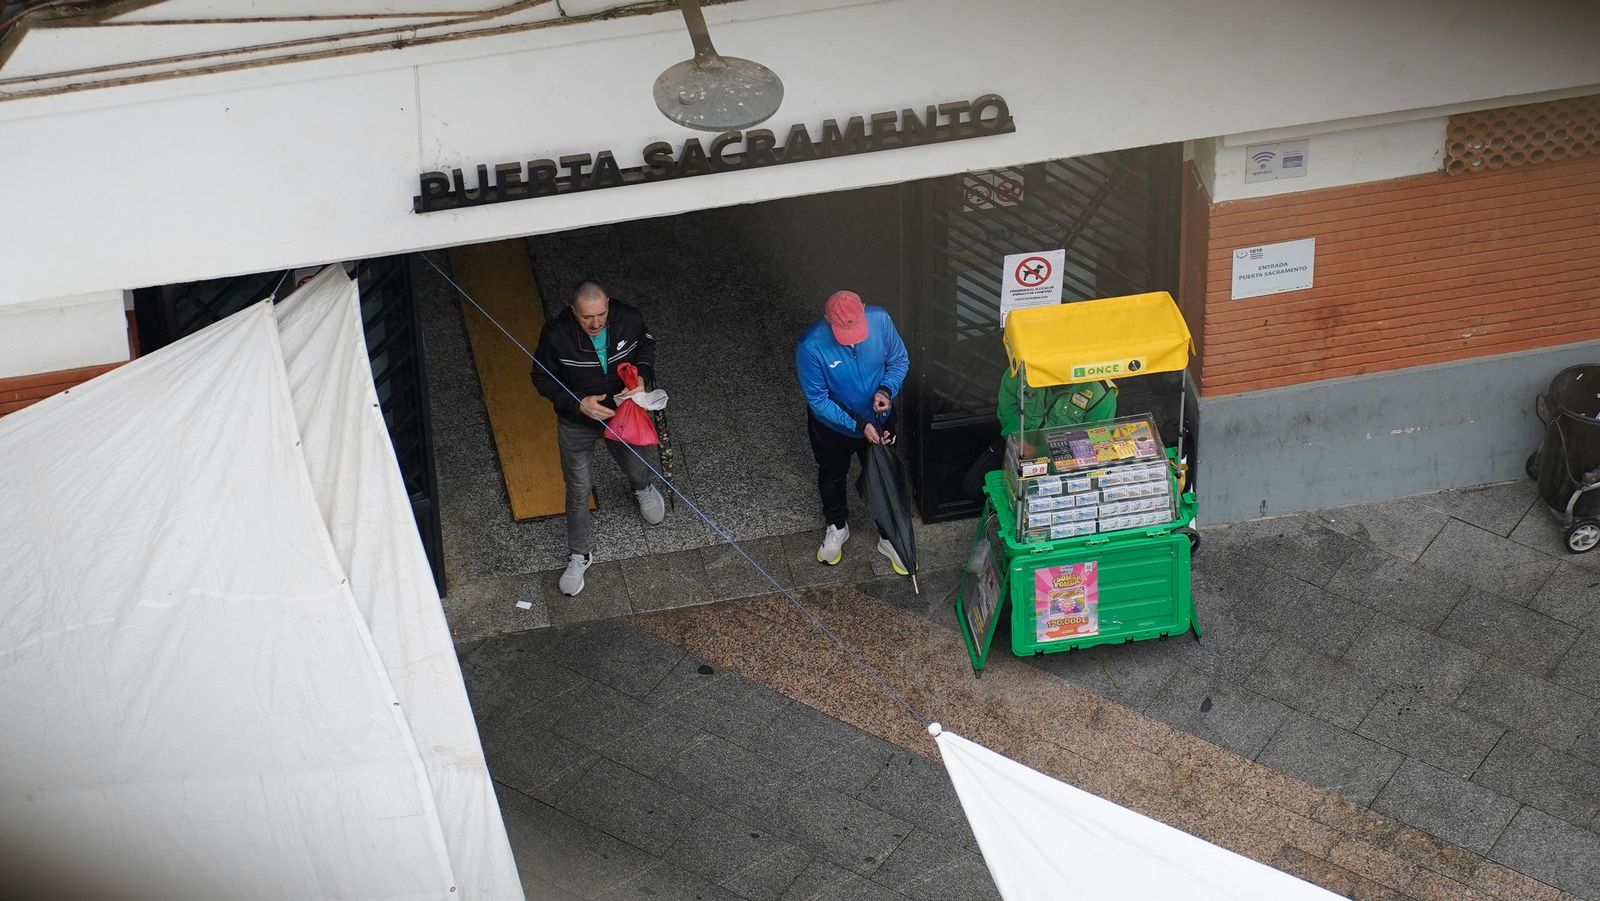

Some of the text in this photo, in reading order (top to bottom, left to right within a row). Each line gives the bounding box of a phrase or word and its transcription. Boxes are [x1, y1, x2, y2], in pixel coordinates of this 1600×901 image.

[419, 93, 1011, 210] PUERTA SACRAMENTO
[1238, 265, 1308, 280] PUERTA SACRAMENTO
[1258, 262, 1289, 271] ENTRADA
[1087, 364, 1120, 375] ONCE
